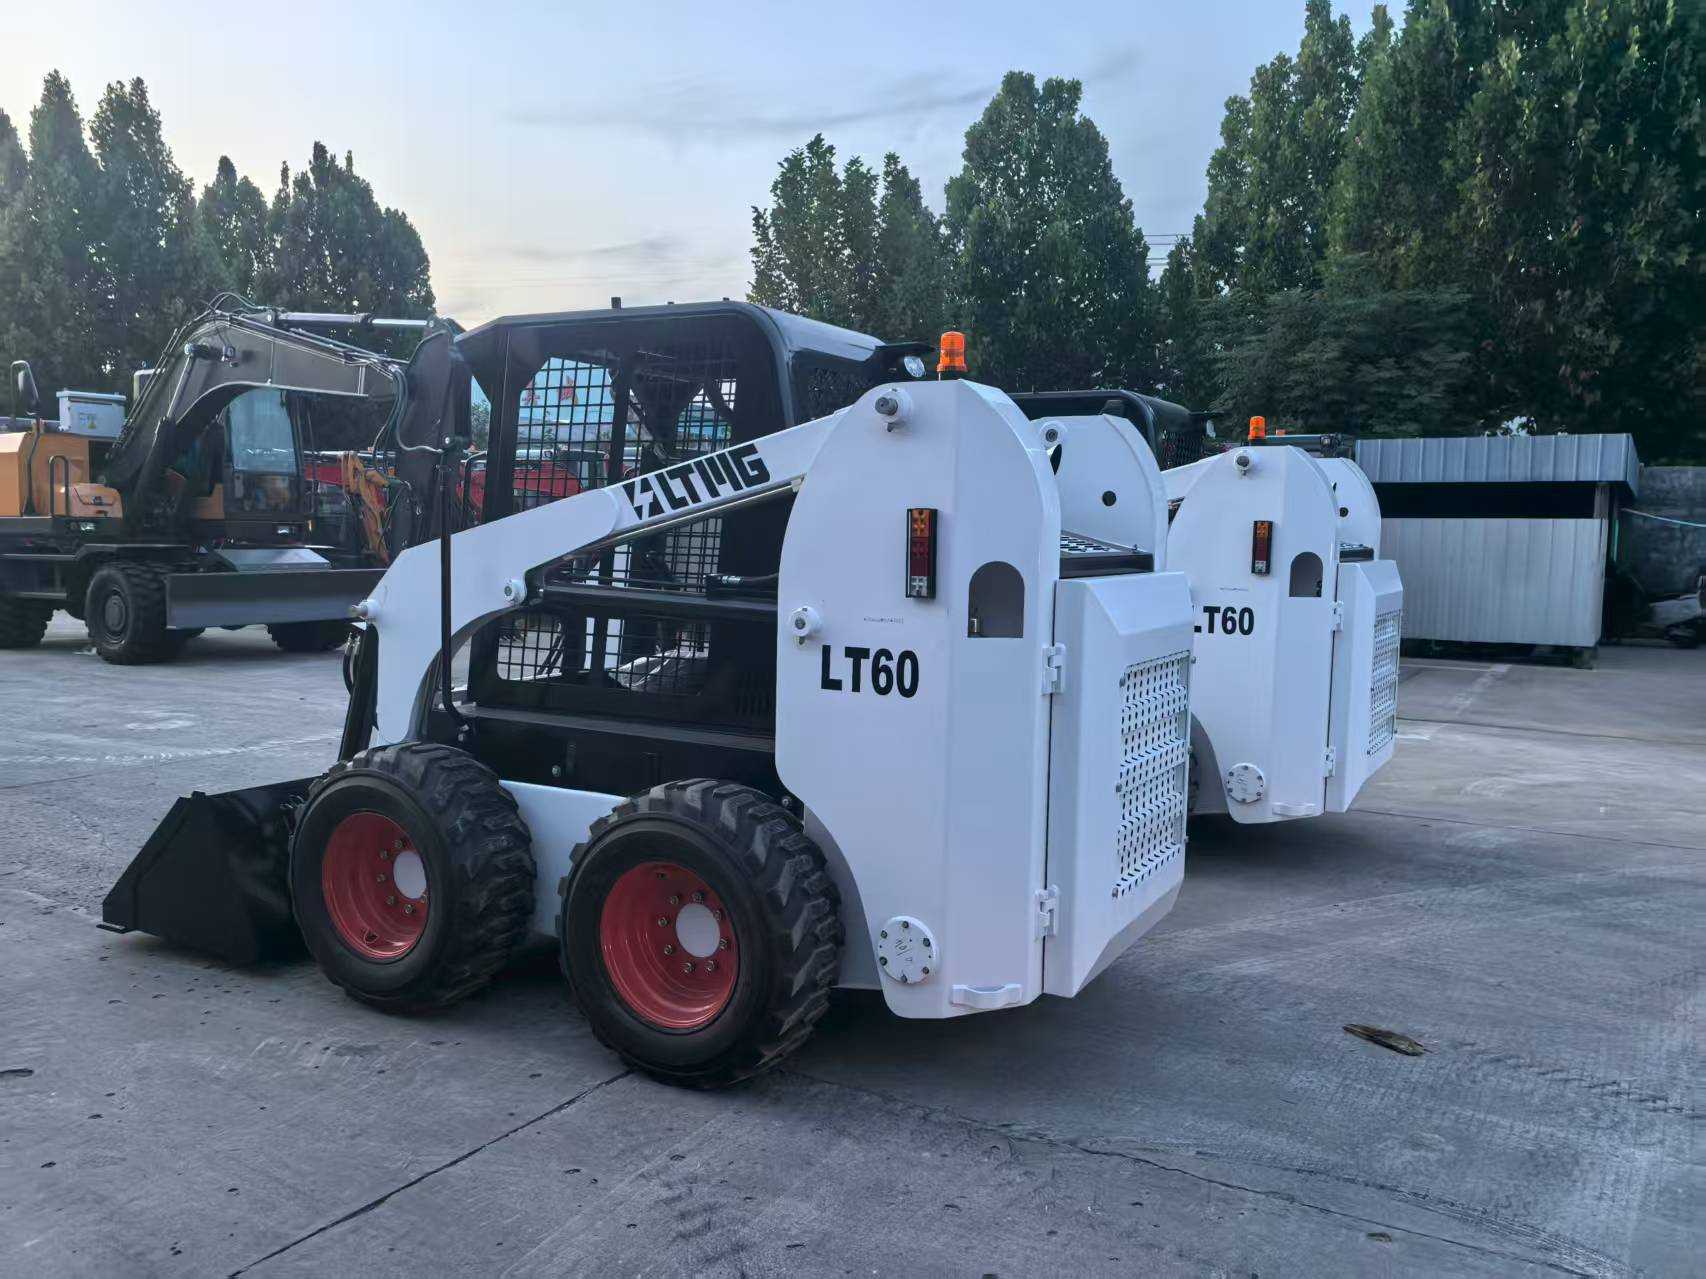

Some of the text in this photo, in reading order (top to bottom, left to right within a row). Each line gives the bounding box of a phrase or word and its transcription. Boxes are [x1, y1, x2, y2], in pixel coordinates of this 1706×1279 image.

[655, 443, 771, 511] LTMG
[1194, 606, 1254, 636] T60
[821, 644, 919, 698] LT60
